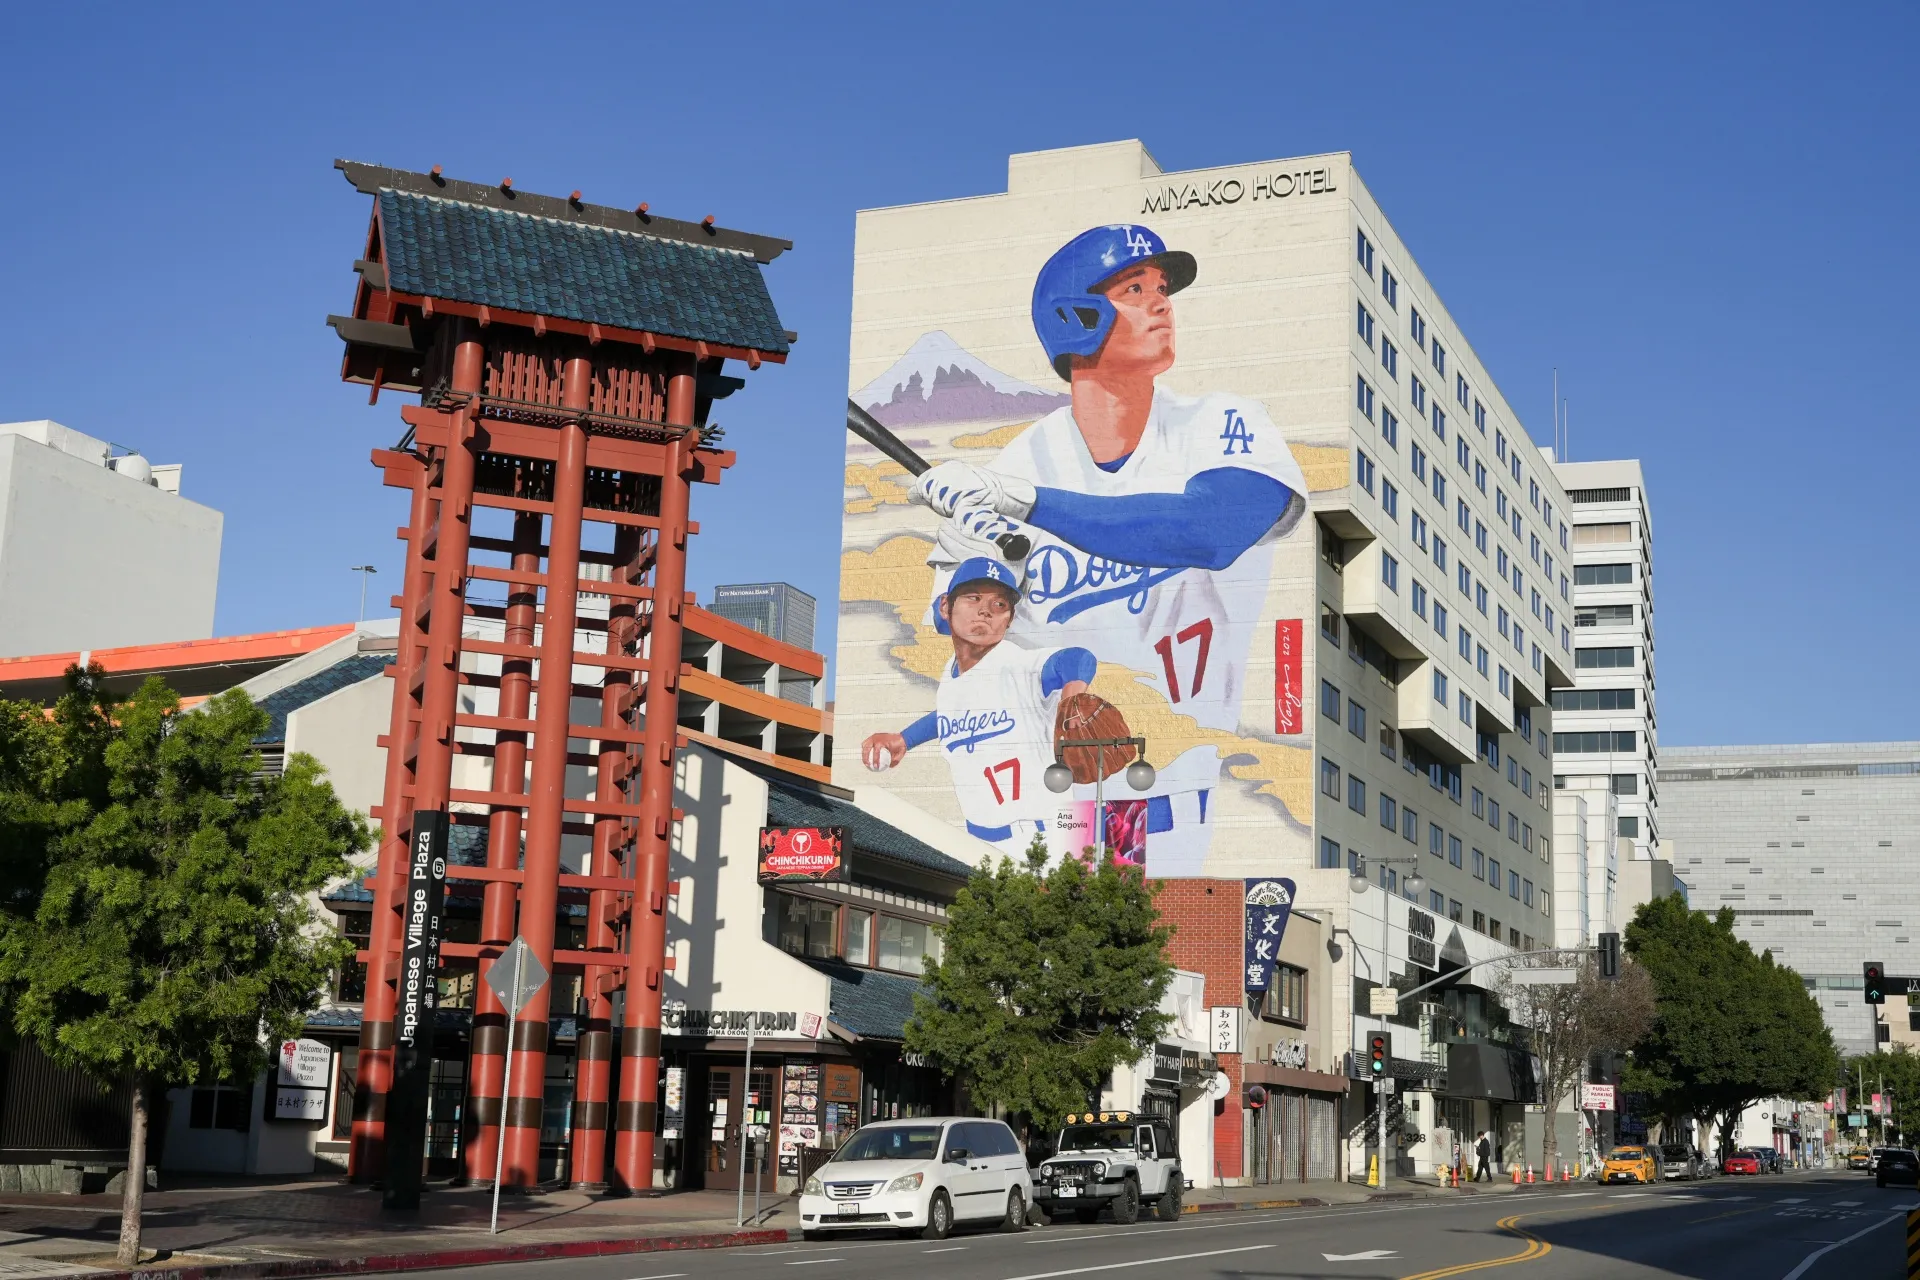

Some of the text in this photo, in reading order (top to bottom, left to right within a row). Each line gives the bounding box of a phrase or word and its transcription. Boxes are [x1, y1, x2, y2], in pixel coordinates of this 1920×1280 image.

[1141, 167, 1336, 214] MIYAKO HOTEL
[1123, 225, 1152, 256] LA
[1220, 409, 1254, 455] LA
[987, 562, 1000, 580] LA
[1153, 617, 1213, 704] 17
[1278, 664, 1301, 733] Vargas
[937, 709, 1015, 754] Dodgers
[983, 757, 1020, 805] 17
[1057, 812, 1073, 820] Ana
[1057, 821, 1088, 830] Segovia
[768, 855, 833, 866] CHINCHIKURIN
[400, 831, 431, 1048] Japanese Village Plaza
[1247, 913, 1280, 986] 文化堂
[424, 915, 439, 1009] 日本村広場
[666, 1010, 796, 1031] CHINCHIKURIN
[1218, 1009, 1230, 1051] おみやげ
[298, 1044, 323, 1054] Welcome
[298, 1054, 328, 1063] Japanese
[297, 1063, 317, 1073] Village
[1155, 1054, 1168, 1068] CITY
[1167, 1056, 1180, 1070] HAIR
[296, 1073, 314, 1081] Plaza
[277, 1097, 323, 1108] 日本村プラザ
[1406, 1133, 1426, 1143] 328
